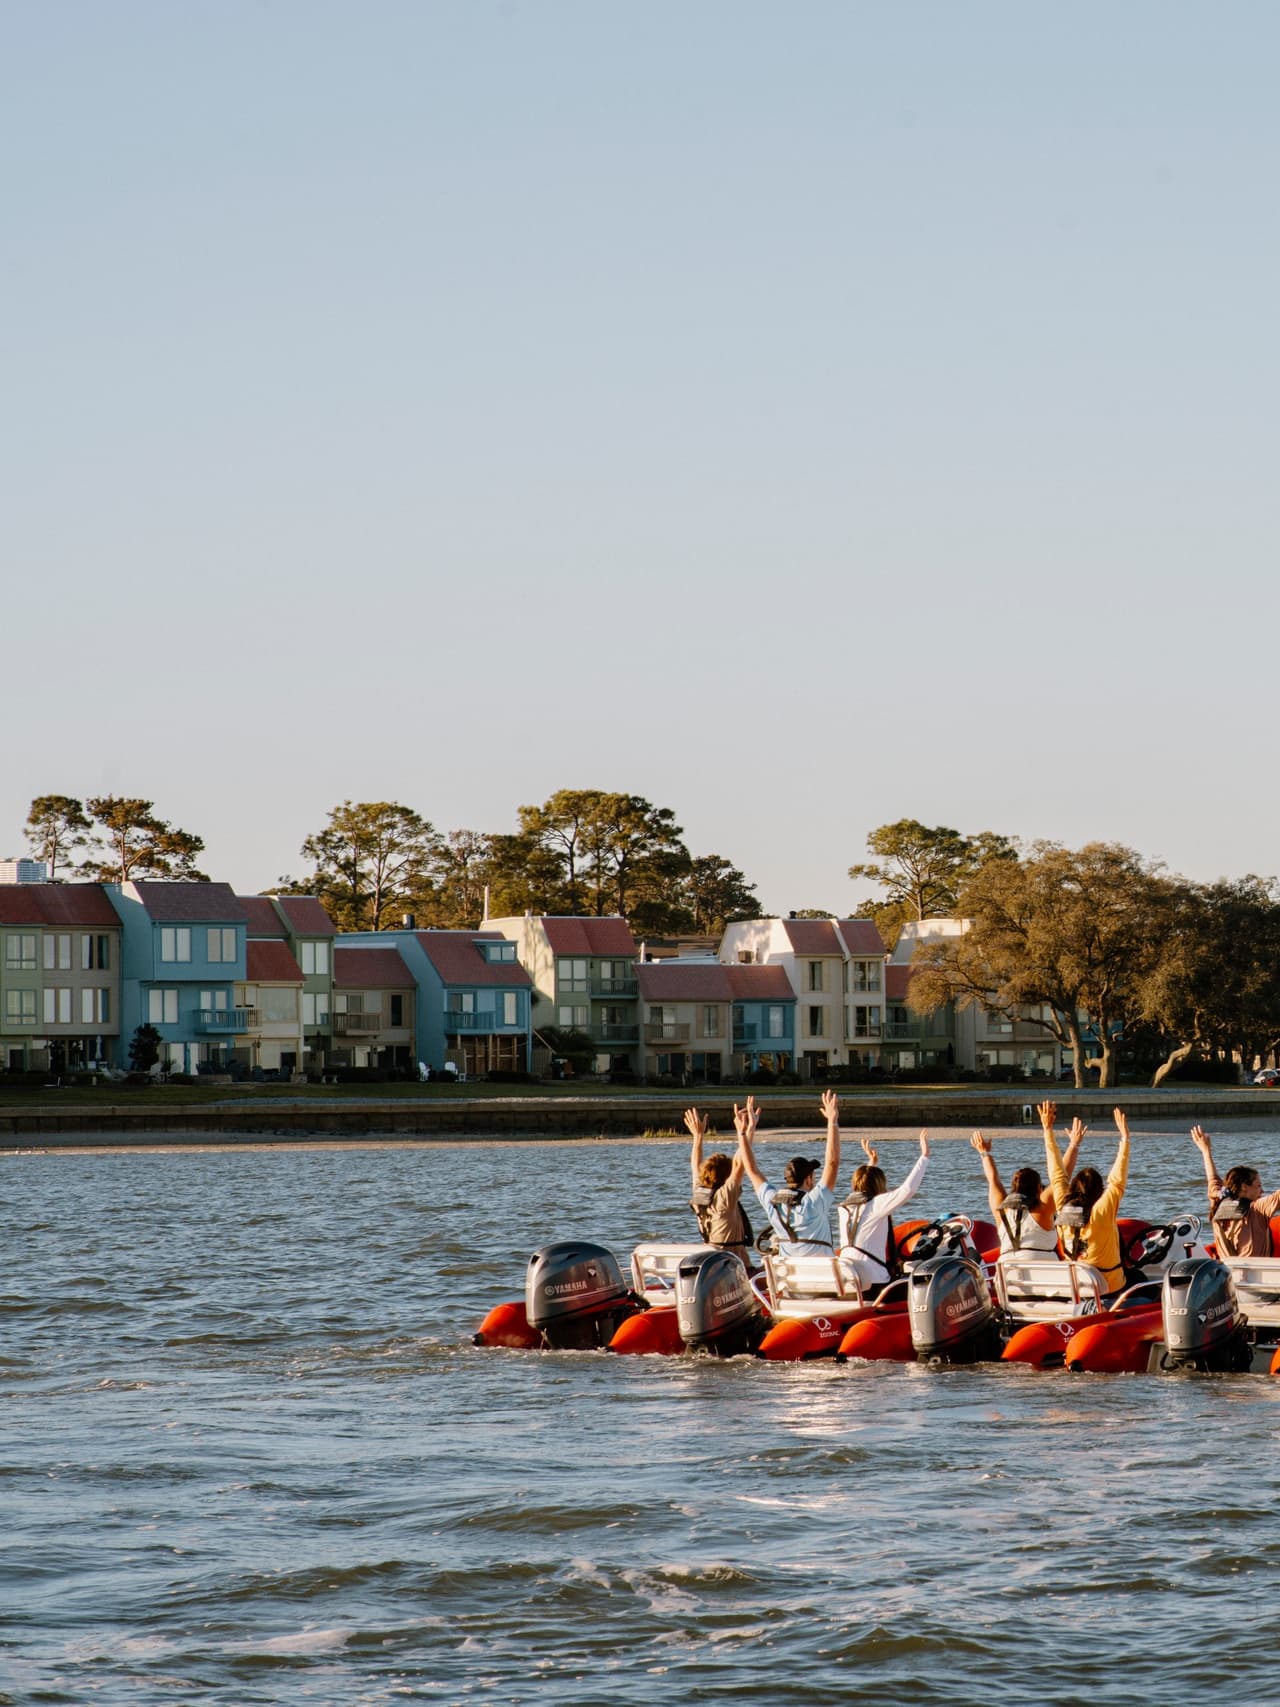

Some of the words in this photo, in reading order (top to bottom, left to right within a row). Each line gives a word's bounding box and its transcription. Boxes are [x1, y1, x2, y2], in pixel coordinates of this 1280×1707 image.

[554, 1281, 588, 1295] YAMAHA
[680, 1296, 696, 1304] 50
[912, 1304, 928, 1313] 50
[1168, 1308, 1187, 1316] 50
